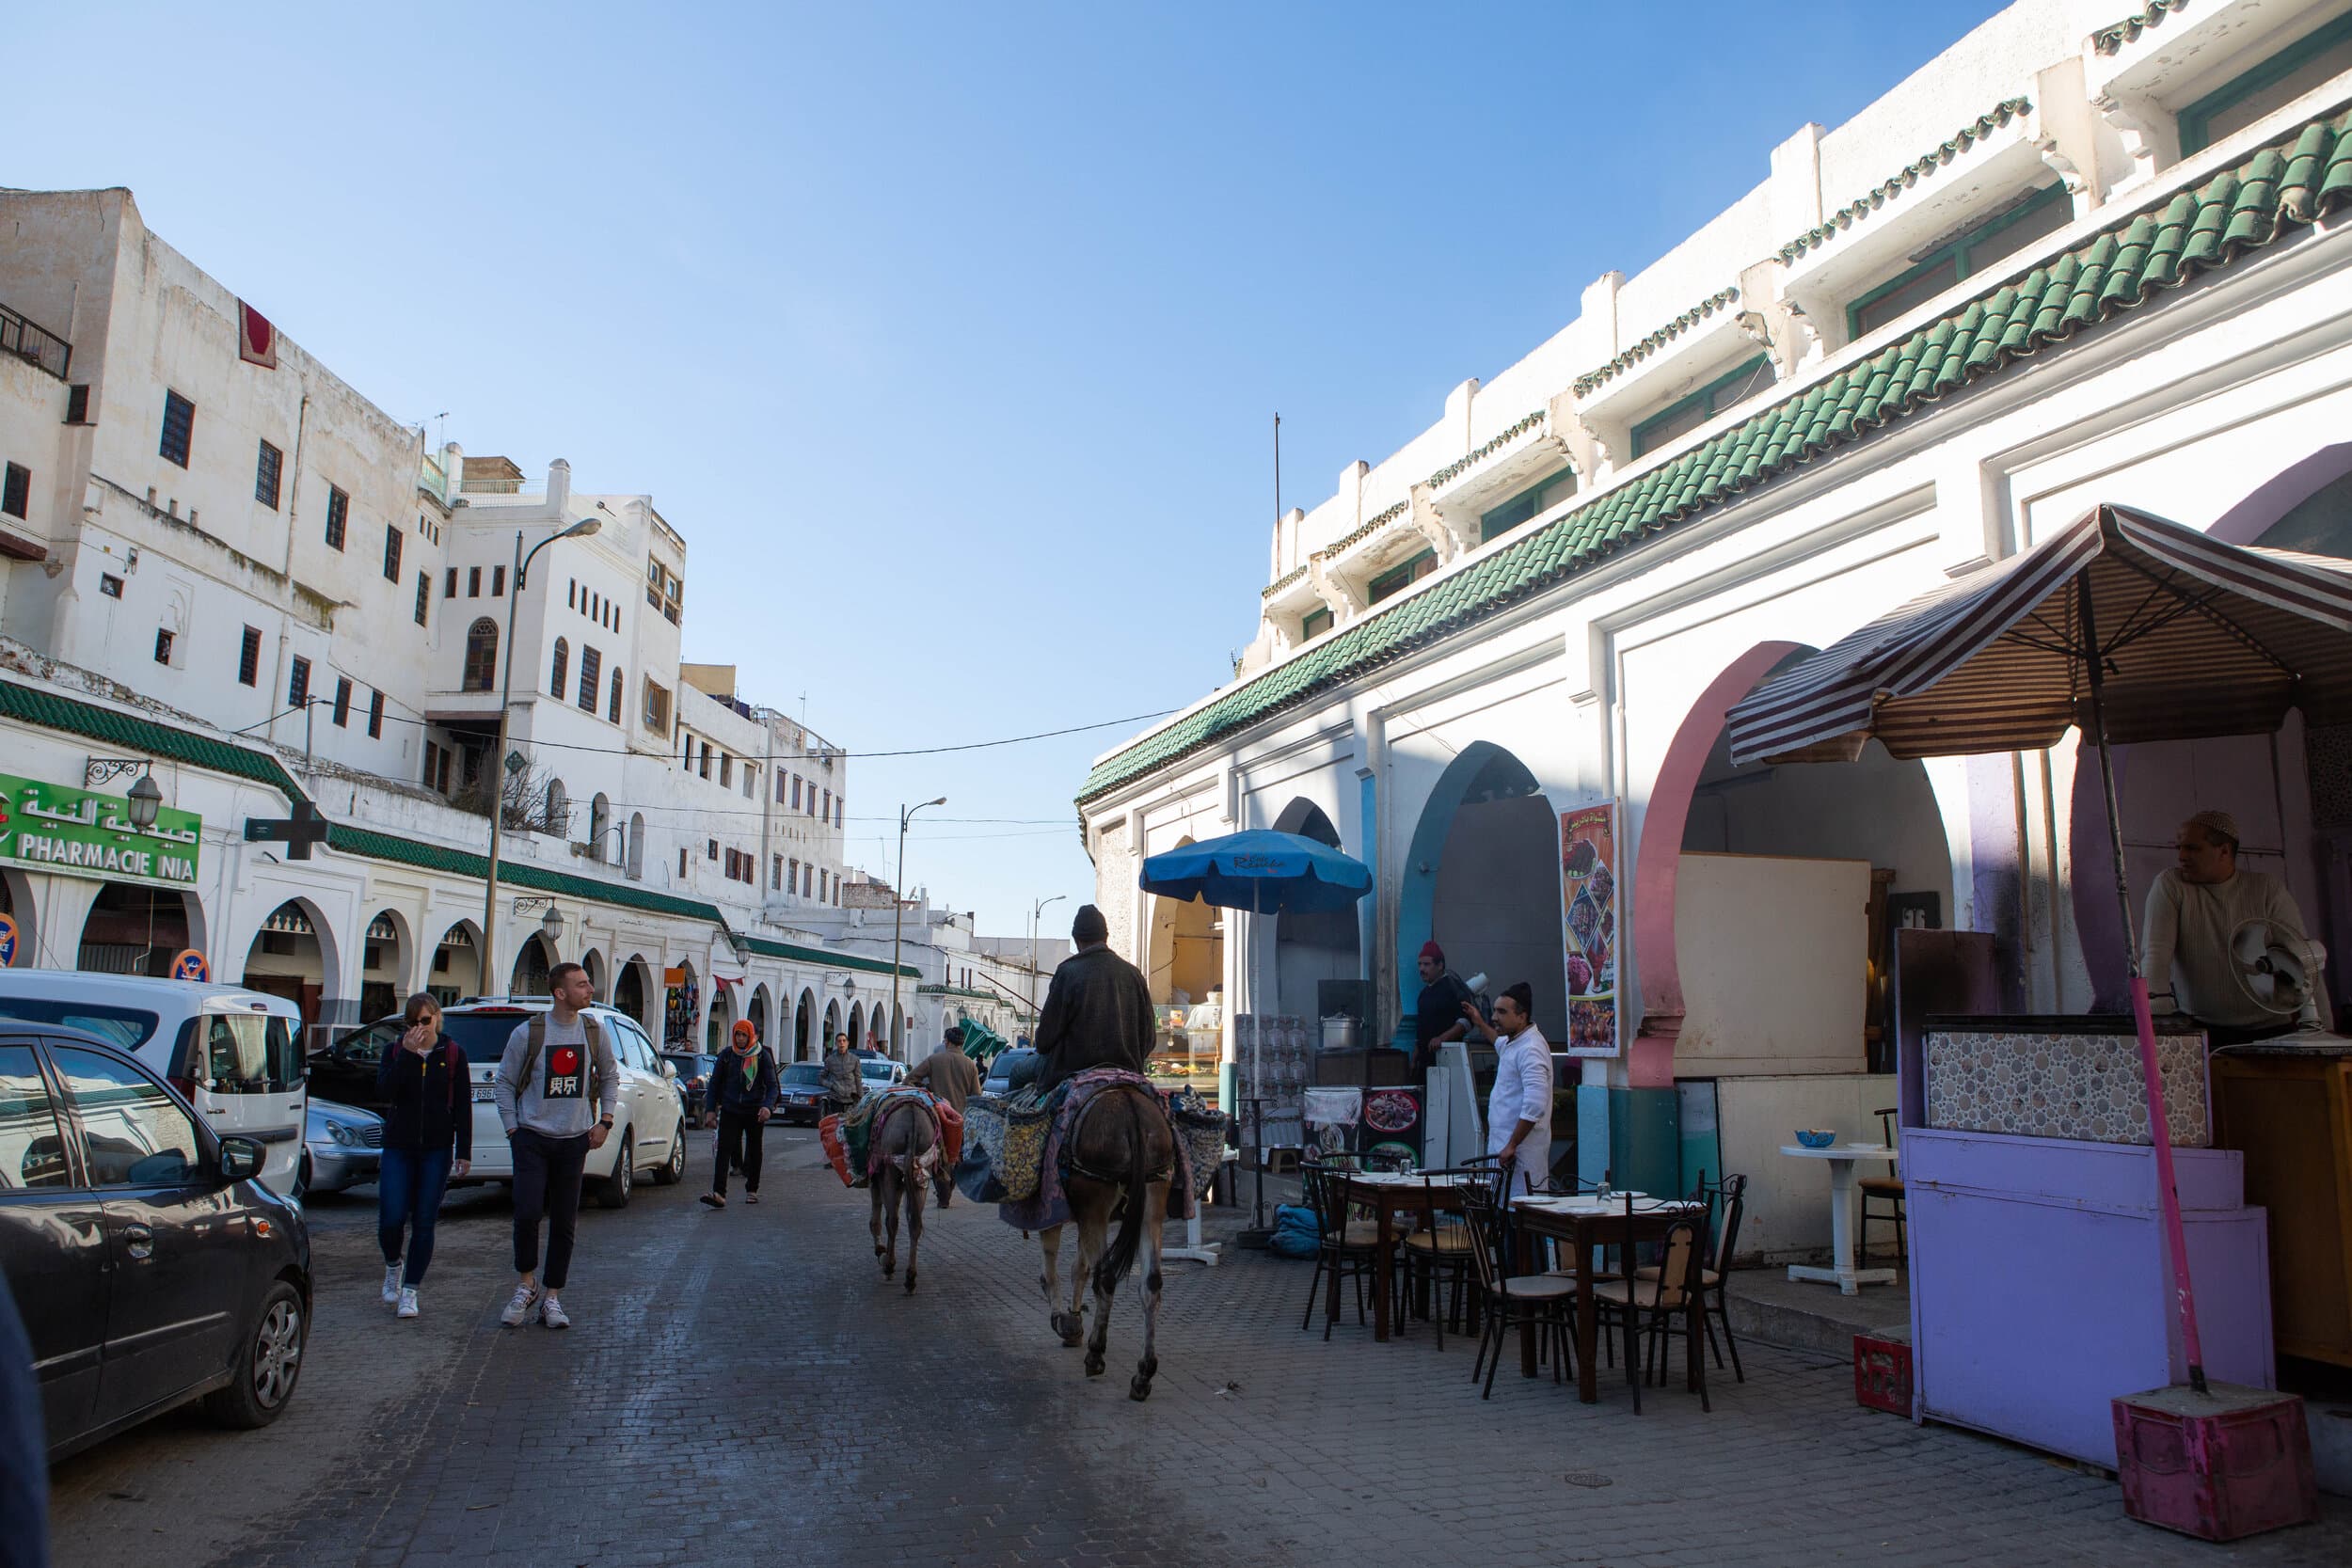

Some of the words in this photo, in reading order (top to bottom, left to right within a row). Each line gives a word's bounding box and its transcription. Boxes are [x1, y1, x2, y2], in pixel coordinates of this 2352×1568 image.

[21, 788, 98, 829] النية
[102, 802, 197, 848] صيدية
[18, 833, 151, 875] PHARMACIE
[158, 855, 194, 880] NIA
[549, 1076, 578, 1096] 東京
